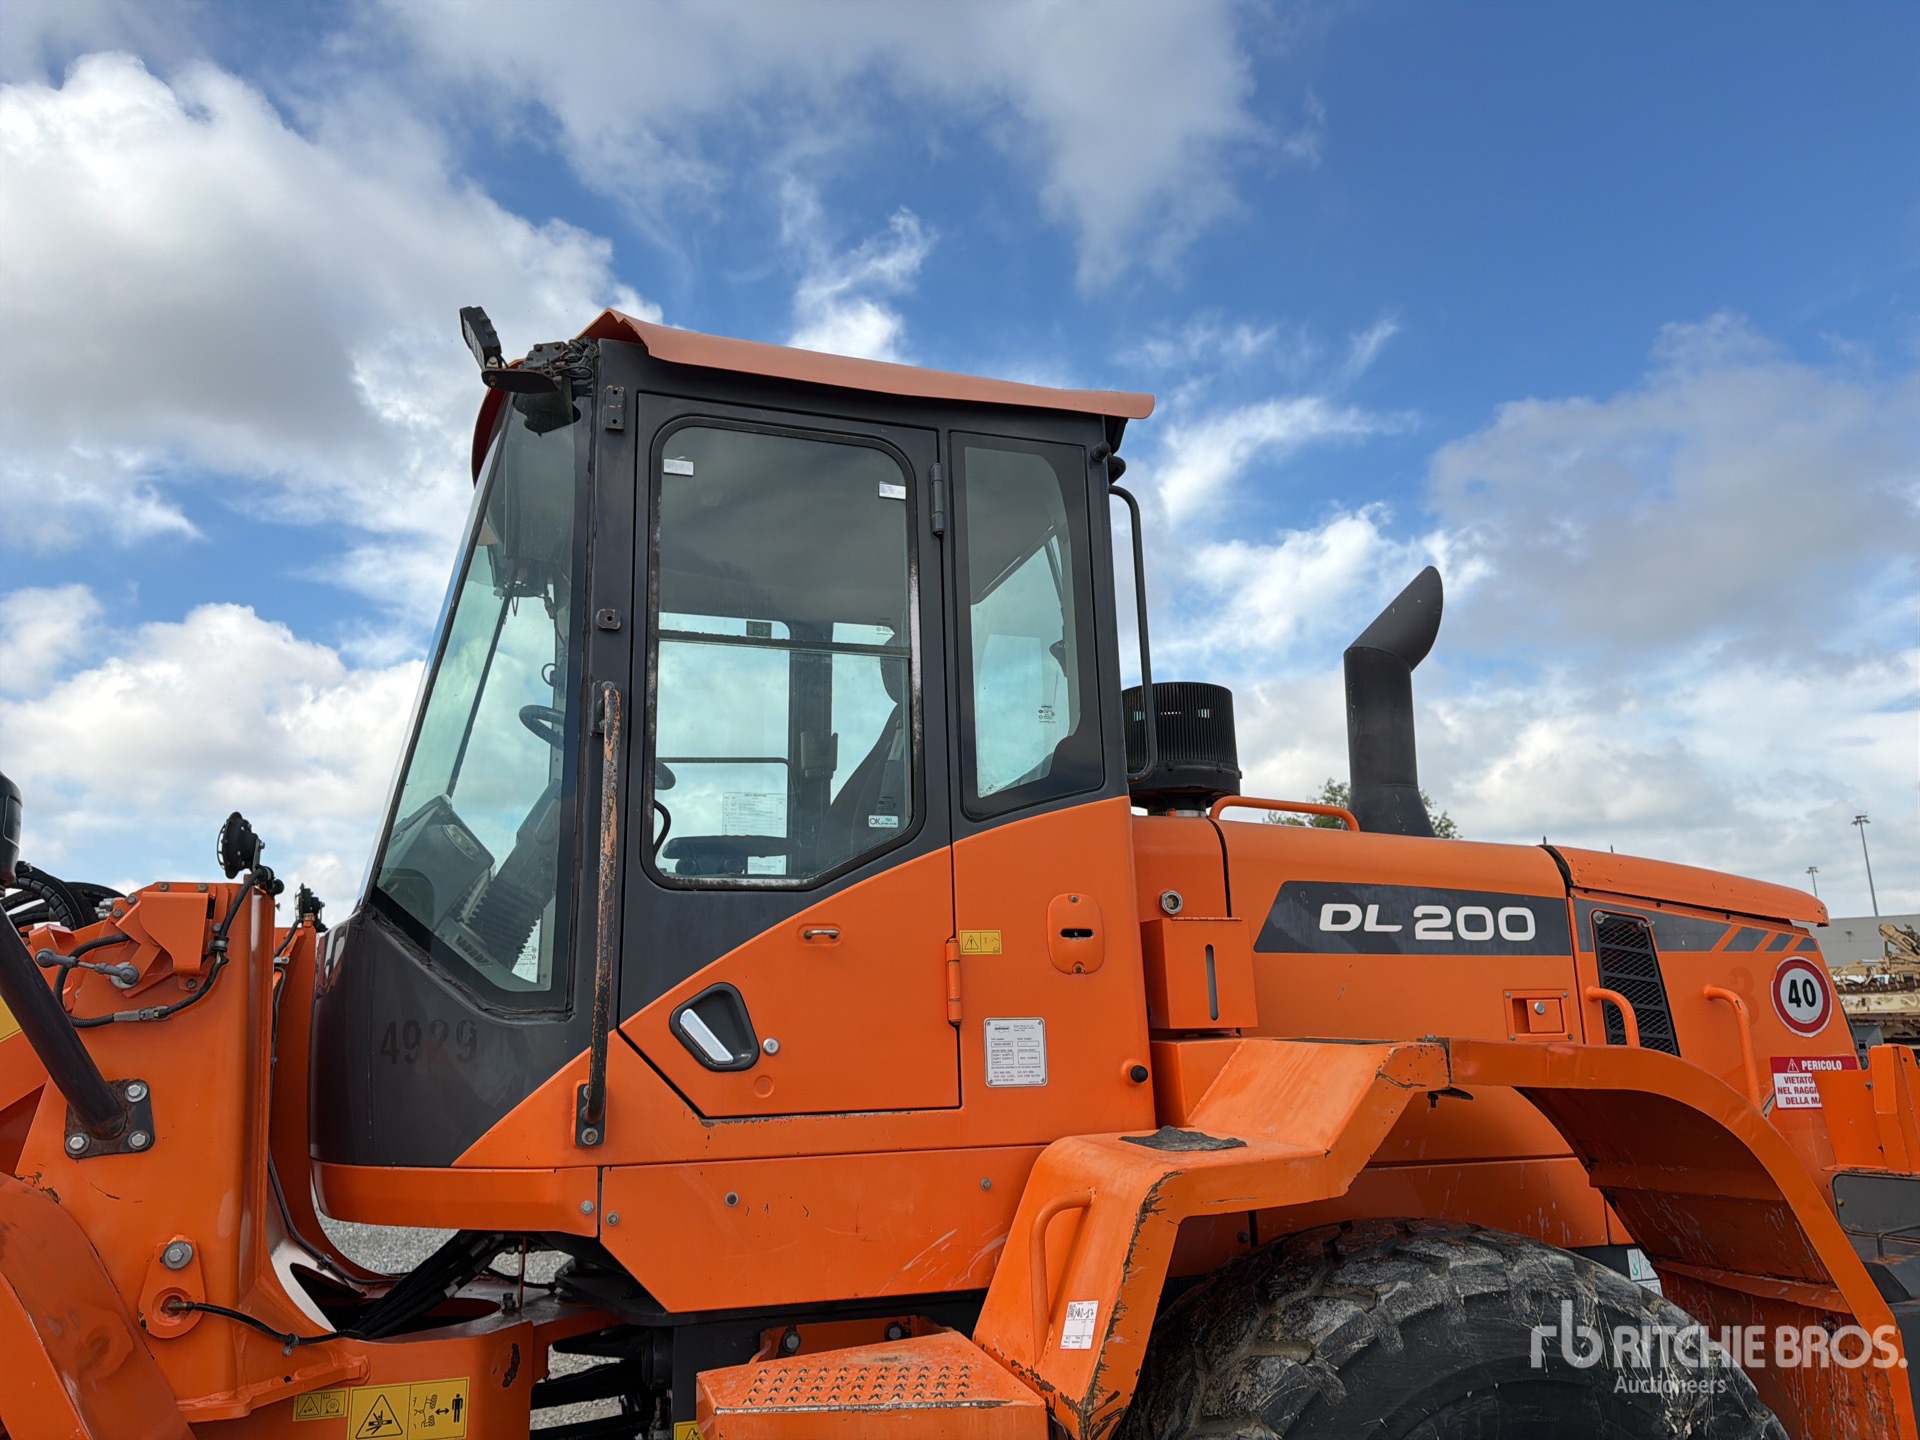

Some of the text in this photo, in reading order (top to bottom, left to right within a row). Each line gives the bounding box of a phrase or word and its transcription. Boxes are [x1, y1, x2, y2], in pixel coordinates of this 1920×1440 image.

[1319, 903, 1536, 941] DL 200
[1788, 979, 1817, 1008] 40
[1801, 1060, 1842, 1071] PERICOLO
[1777, 1086, 1817, 1094] NEL RAGGI
[1785, 1097, 1809, 1105] DELLA
